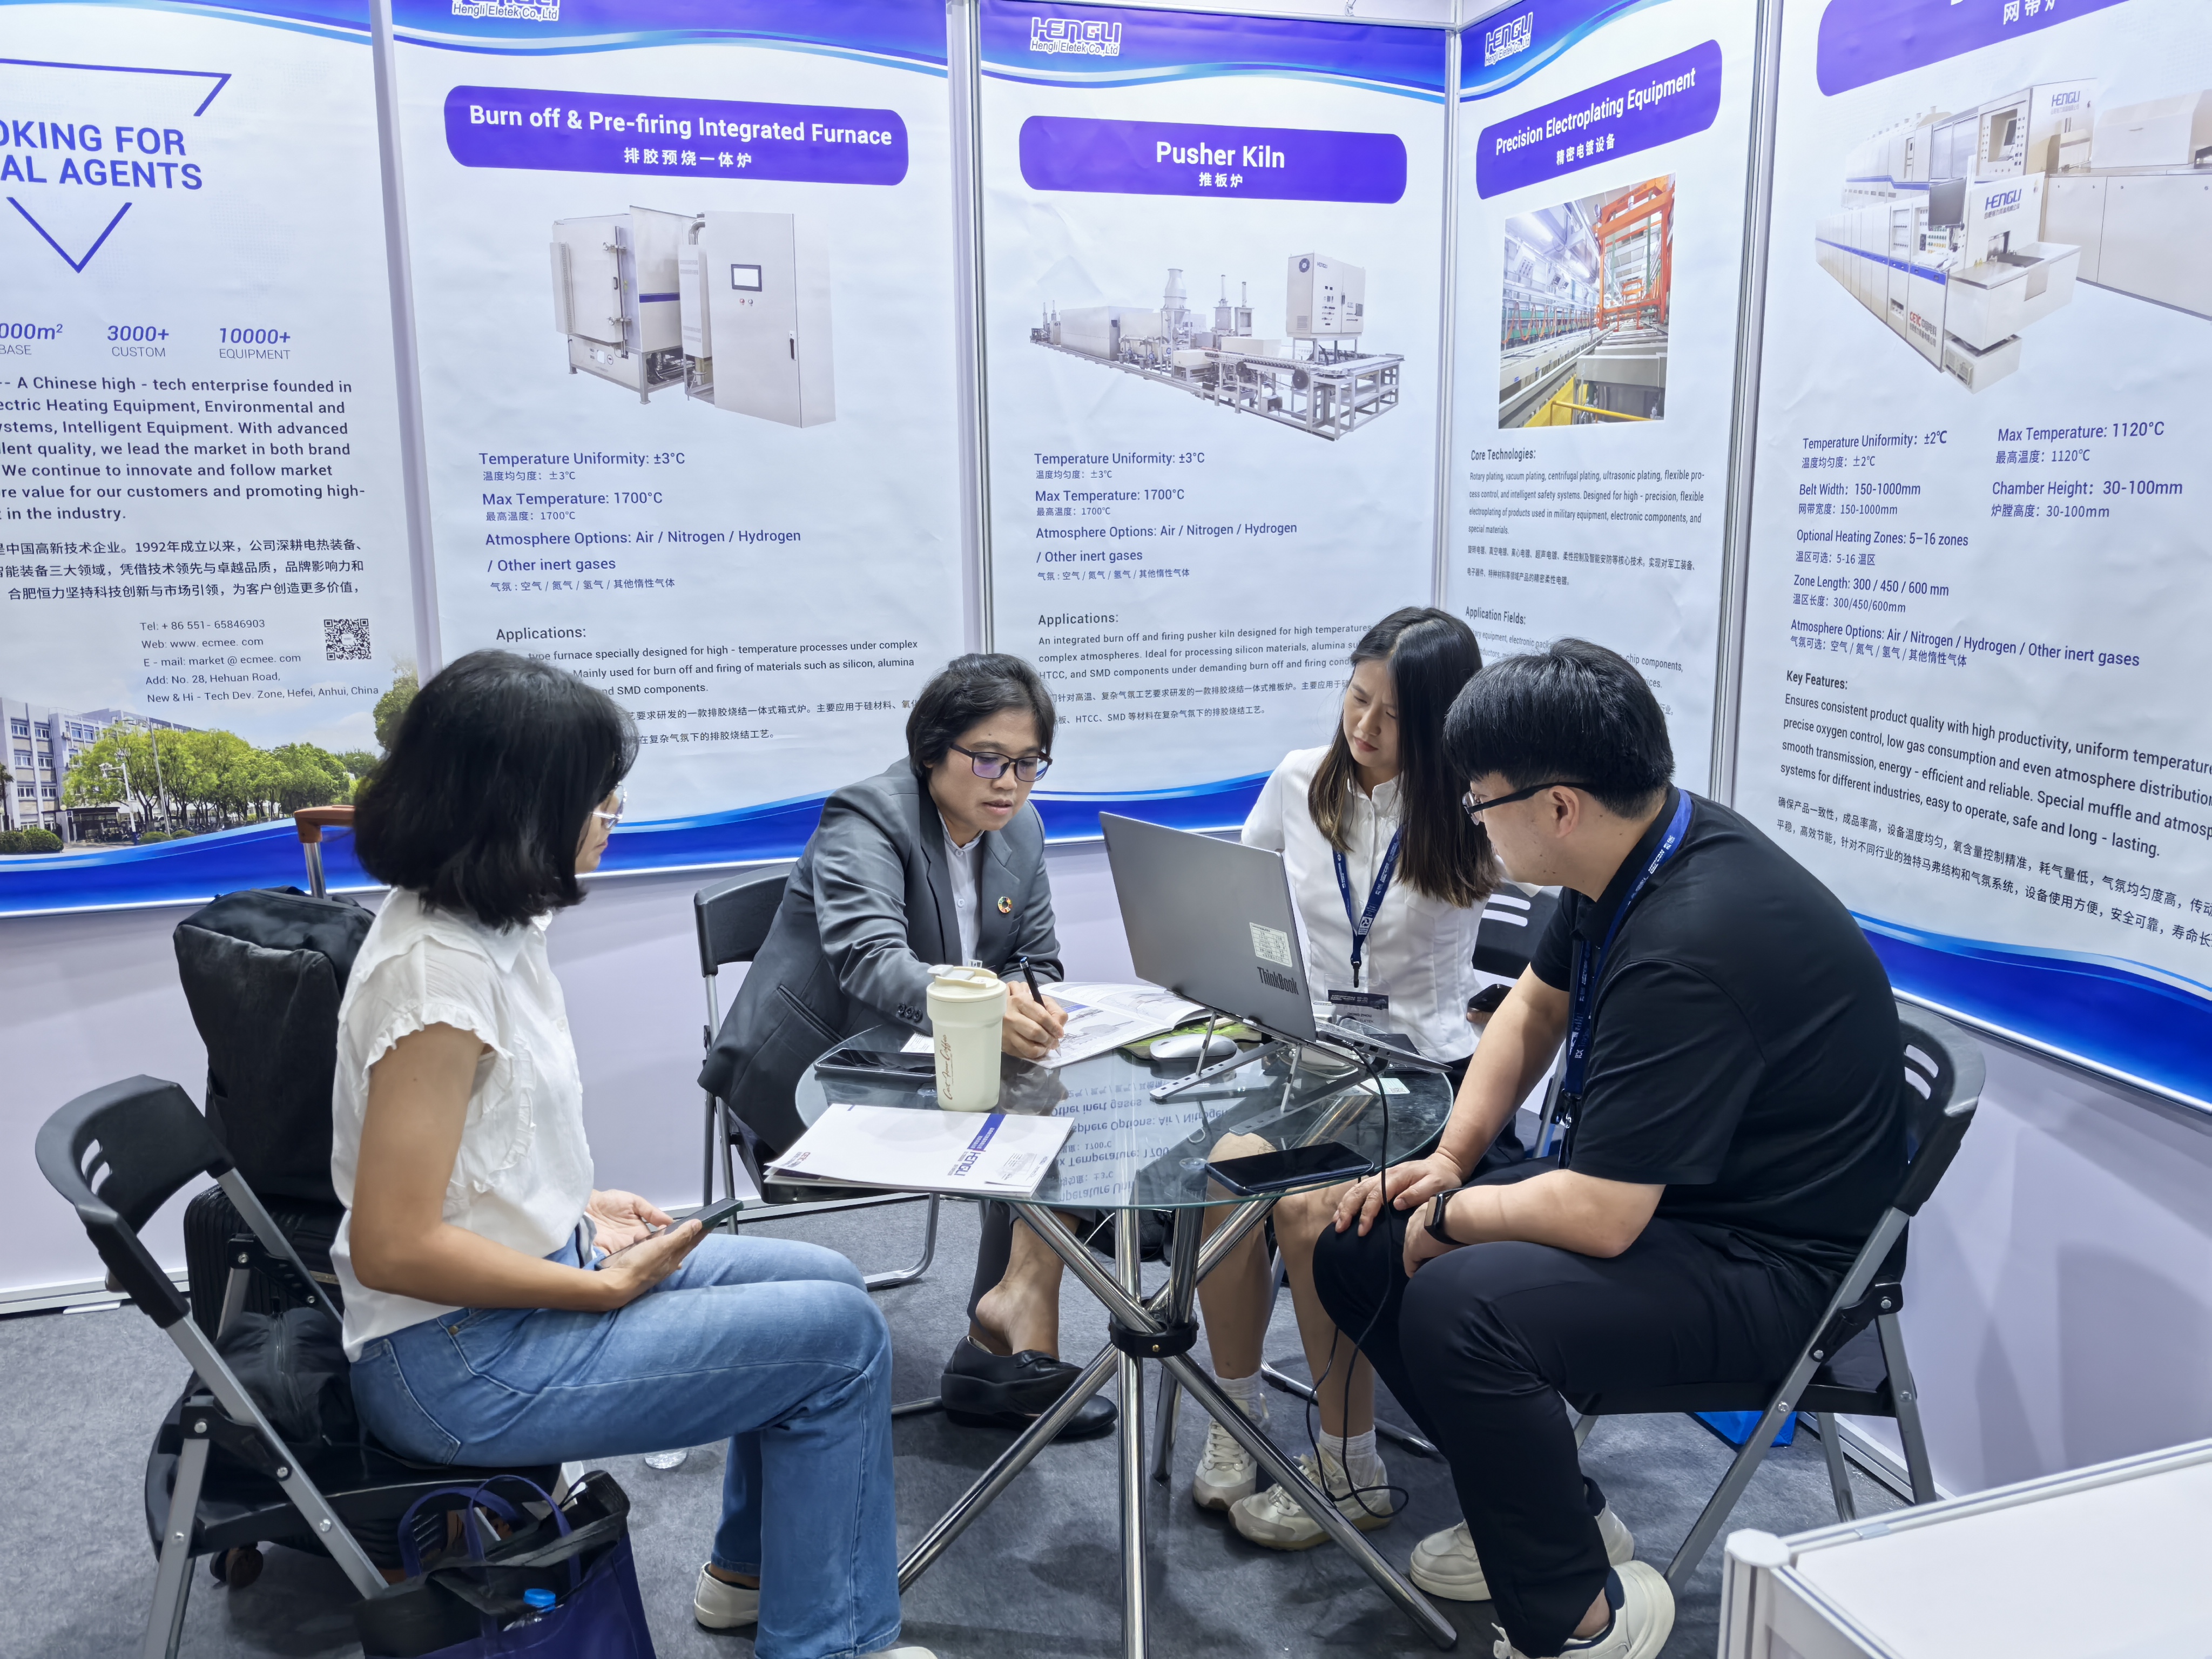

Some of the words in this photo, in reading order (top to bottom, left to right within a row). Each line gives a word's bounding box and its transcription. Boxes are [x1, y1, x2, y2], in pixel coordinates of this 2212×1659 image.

[453, 3, 485, 17] Hengli
[488, 5, 520, 17] Eletek
[1032, 18, 1121, 43] HENGLI
[1486, 12, 1533, 54] HENGLI
[1031, 40, 1058, 53] Hengli
[1060, 42, 1087, 53] Eletek
[1496, 126, 1542, 156] Precision
[1546, 97, 1623, 138] Electroplating
[1628, 68, 1695, 111] Equipment
[470, 105, 522, 126] Burn
[530, 107, 560, 128] off
[567, 110, 582, 129] &
[590, 111, 691, 140] Pre-firing
[699, 117, 804, 142] Integrated
[812, 123, 892, 145] Furnace
[116, 126, 186, 156] FOR
[624, 147, 751, 168] 排胶预烧一体炉
[1157, 141, 1236, 166] Pusher
[1243, 145, 1284, 168] Kiln
[1556, 133, 1615, 166] 精密电镀设备
[59, 158, 202, 190] AGENTS
[1199, 172, 1243, 188] 推板炉
[107, 326, 168, 341] 3000+
[220, 328, 291, 345] 10000+
[112, 347, 165, 357] CUSTOM
[220, 349, 291, 359] EQUIPMENT
[1998, 428, 2022, 442] Max
[2026, 426, 2108, 442] Temperature:
[38, 442, 96, 457] quality,
[101, 446, 122, 454] we
[127, 442, 159, 454] lead
[165, 443, 188, 454] the
[194, 443, 247, 454] market
[252, 443, 265, 454] in
[271, 443, 303, 455] both
[309, 443, 349, 455] brand
[1803, 437, 1859, 451] Temperature
[478, 453, 569, 467] Temperature
[574, 452, 649, 467] Uniformity:
[1034, 453, 1109, 467] Temperature
[1112, 452, 1175, 466] Uniformity:
[1472, 450, 1485, 460] Core
[1488, 448, 1536, 462] Technologies:
[1603, 470, 1635, 480] ultrasonic
[1637, 470, 1662, 482] plating,
[1665, 470, 1689, 480] flexible
[1691, 472, 1704, 482] pro-
[1799, 483, 1817, 495] Belt
[1856, 483, 1920, 495] 150-1000mm
[1992, 481, 2044, 496] Chamber
[2103, 480, 2183, 496] 30-100mm
[483, 493, 512, 505] Max
[516, 493, 609, 508] Temperature:
[1036, 490, 1060, 501] Max
[1063, 490, 1139, 504] Temperature:
[7, 508, 21, 519] in
[26, 507, 51, 519] the
[57, 507, 125, 521] industry.
[1797, 529, 1833, 543] Optional
[1836, 530, 1871, 546] Heating
[1874, 531, 1906, 544] Zones:
[1938, 536, 1968, 546] zones
[1038, 612, 1118, 628] Applications:
[1466, 606, 1501, 621] Application
[1503, 611, 1526, 625] Fields:
[139, 622, 159, 631] Tel:
[171, 621, 184, 630] 86
[214, 619, 265, 629] 65846903
[496, 626, 585, 643] Applications:
[1039, 653, 1077, 664] complex
[1080, 651, 1142, 662] atmospheres.
[1146, 649, 1166, 658] Ideal
[1170, 649, 1182, 657] for
[1185, 646, 1232, 658] processing
[1236, 645, 1263, 654] silicon
[1266, 643, 1308, 652] materials,
[1312, 642, 1345, 650] alumina
[610, 667, 633, 676] used
[637, 666, 650, 676] for
[654, 666, 676, 675] burn
[679, 665, 692, 673] off
[696, 664, 713, 673] and
[716, 663, 741, 674] firing
[745, 663, 754, 672] of
[757, 661, 801, 671] materials
[804, 660, 826, 670] such
[843, 659, 875, 669] silicon,
[878, 658, 914, 667] alumina
[1642, 658, 1682, 672] components,
[146, 676, 168, 685] Add:
[171, 676, 189, 684] No.
[192, 675, 207, 684] 28,
[210, 673, 248, 683] Hehuan
[253, 672, 280, 681] Road,
[1787, 670, 1803, 685] Key
[1805, 673, 1847, 690] Features:
[618, 686, 640, 694] SMD
[644, 684, 708, 695] components.
[1785, 693, 1818, 709] Ensures
[1822, 702, 1867, 717] consistent
[1870, 709, 1907, 724] product
[1910, 716, 1944, 733] quality
[1947, 719, 1968, 734] with
[1972, 723, 1995, 740] high
[1998, 731, 2071, 754] productivity,
[2076, 741, 2128, 760] uniform
[1257, 966, 1299, 995] ThinkBook
[940, 1034, 952, 1061] Coffee
